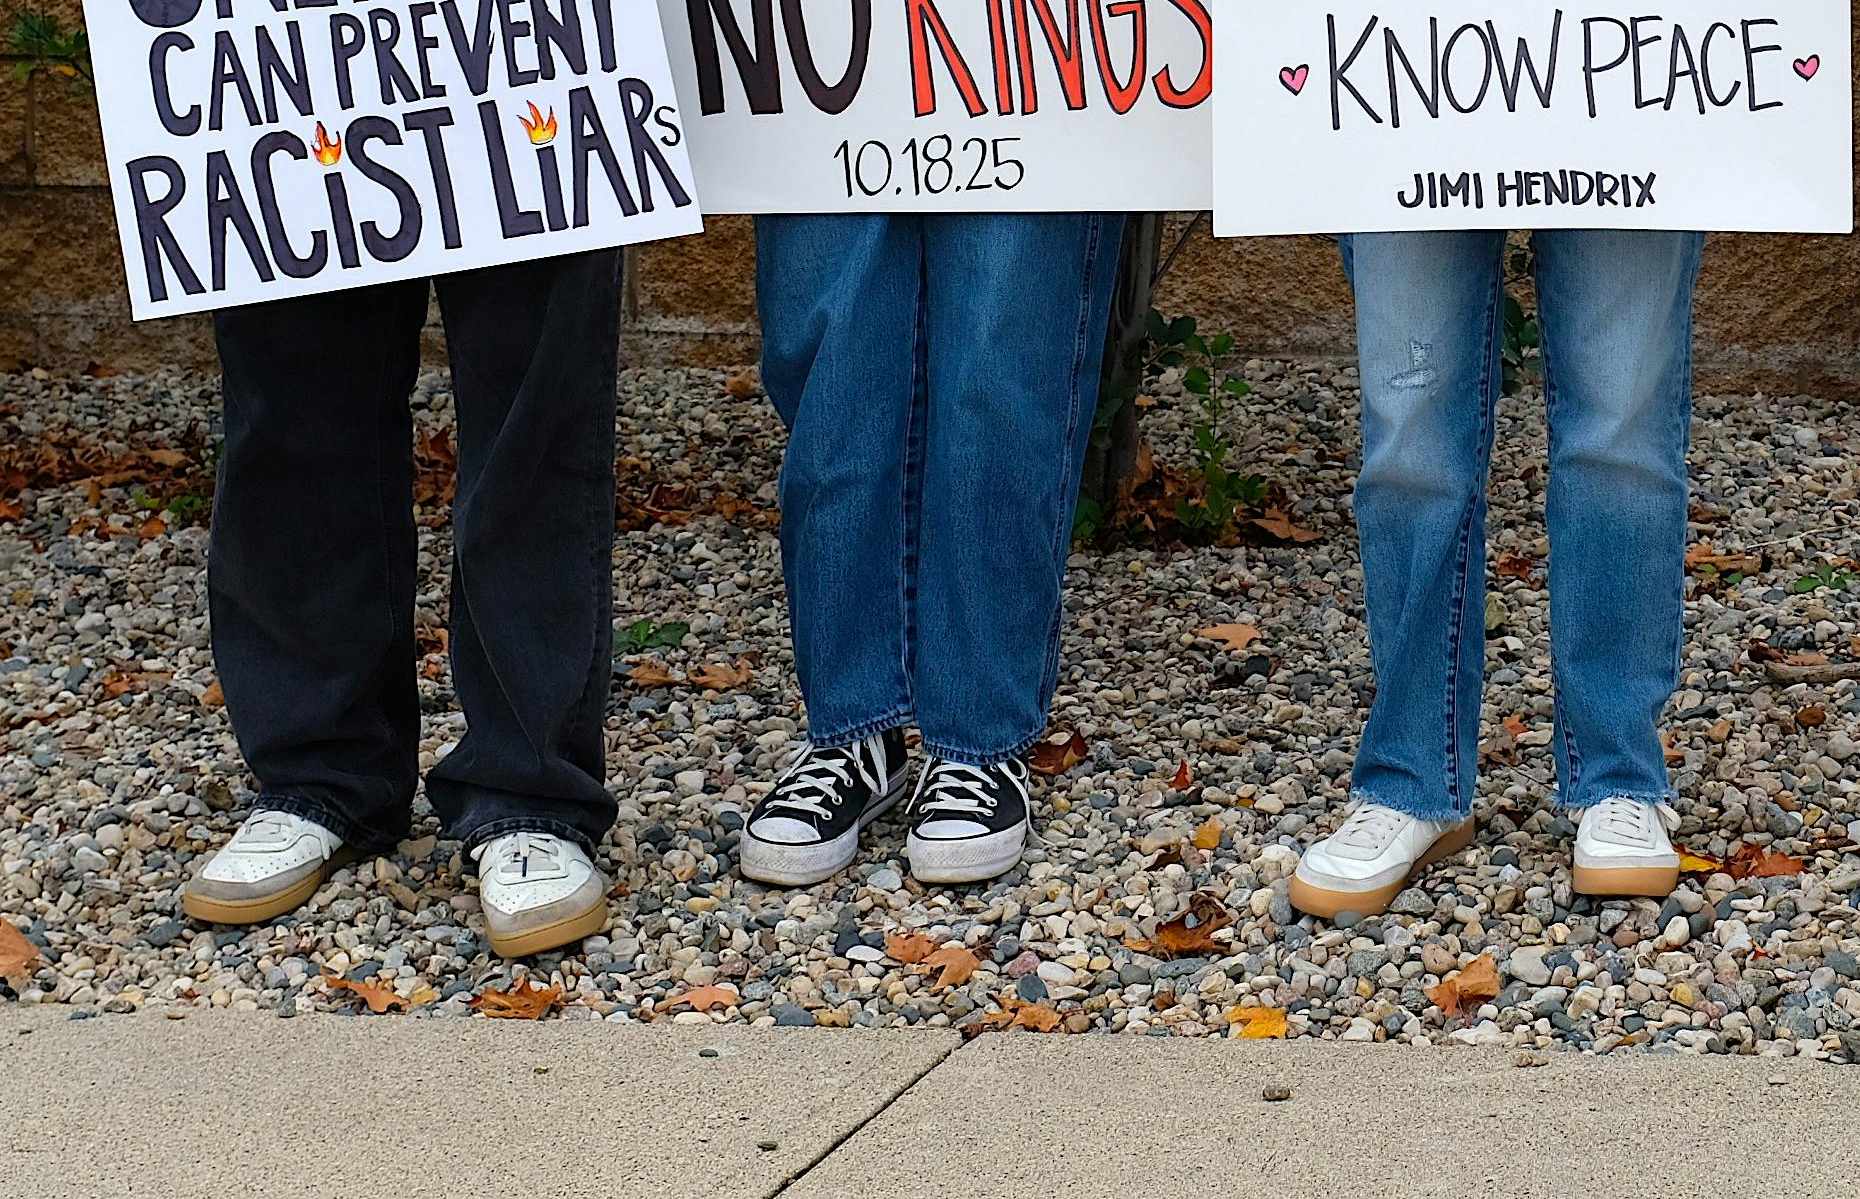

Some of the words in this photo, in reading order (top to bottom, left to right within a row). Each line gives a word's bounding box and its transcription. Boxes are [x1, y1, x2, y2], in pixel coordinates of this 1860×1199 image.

[149, 20, 314, 136] CAN
[1327, 9, 1562, 130] KNOW
[1581, 16, 1783, 118] PEACE
[834, 134, 1024, 198] 10.18.25
[1398, 172, 1483, 209] JIMI
[1497, 169, 1656, 207] HENDRIX
